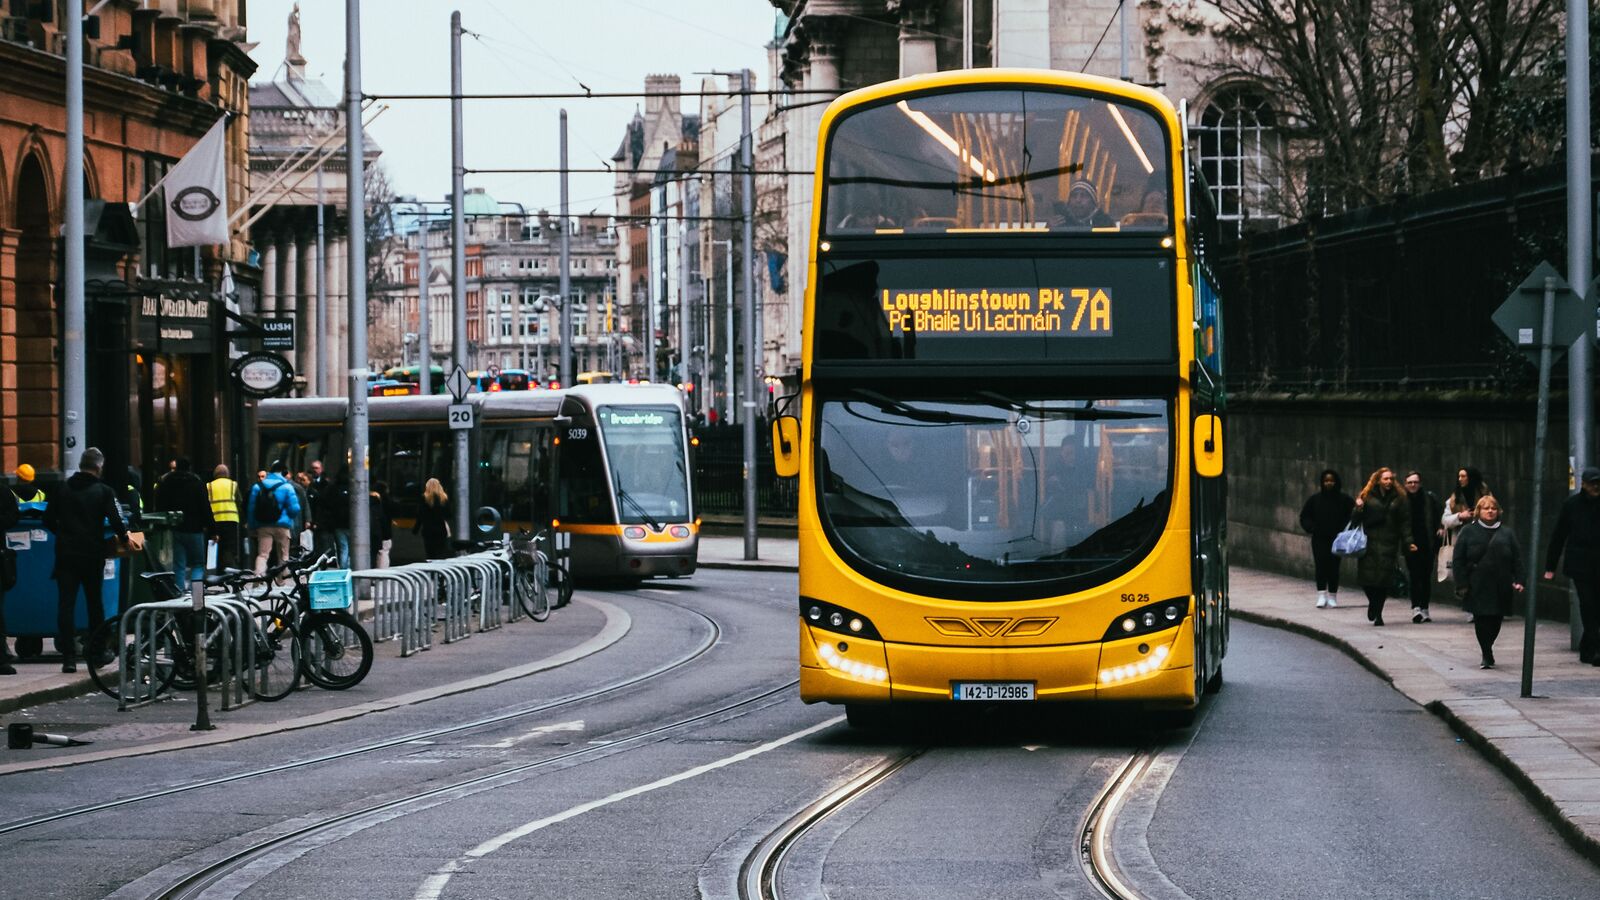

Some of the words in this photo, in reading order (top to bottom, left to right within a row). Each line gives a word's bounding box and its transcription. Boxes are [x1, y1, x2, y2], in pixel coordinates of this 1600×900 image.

[883, 288, 1030, 311] Loughlinstown
[1039, 288, 1065, 311] Pk
[1070, 288, 1111, 331] 7A
[263, 322, 292, 331] LUSH
[889, 310, 911, 332] Pc
[914, 310, 960, 332] Bhaile
[964, 310, 981, 331] Uí
[985, 309, 1060, 331] Lachnáin
[451, 410, 470, 423] 20
[611, 412, 664, 425] Broombridge
[567, 427, 587, 440] 5039
[1120, 593, 1136, 603] SG
[1137, 593, 1150, 603] 25
[964, 686, 1029, 699] 142-D-12986
